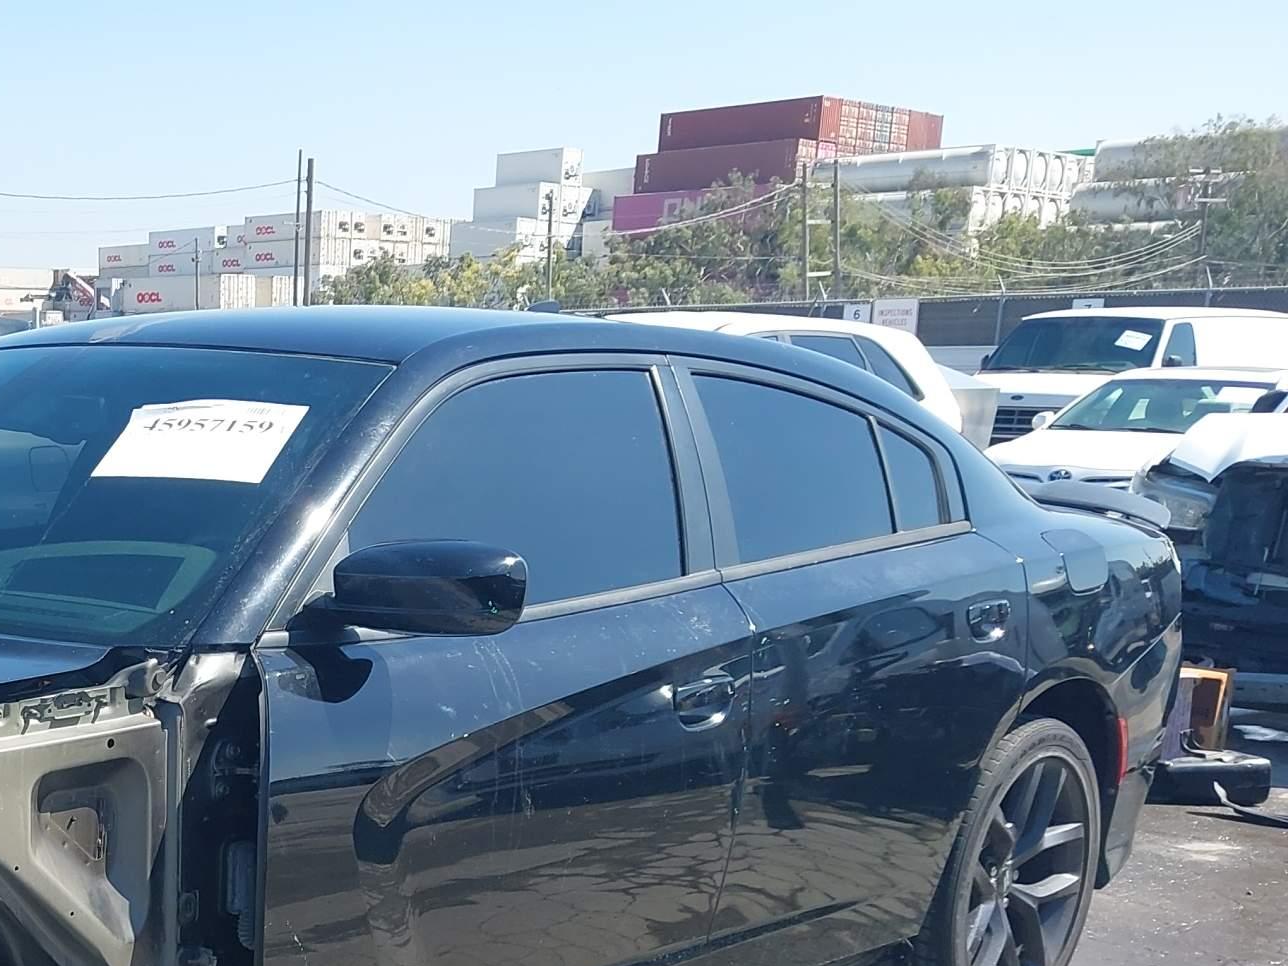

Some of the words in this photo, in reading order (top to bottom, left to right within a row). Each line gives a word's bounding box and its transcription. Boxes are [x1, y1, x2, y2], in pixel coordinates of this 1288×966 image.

[255, 225, 276, 236] OOCL
[158, 240, 177, 249] OOCL
[106, 255, 122, 263] OOCL
[255, 252, 275, 262] OOCL
[158, 263, 176, 273] OOCL
[222, 259, 241, 268] OOCL
[136, 291, 163, 304] OOCL
[853, 309, 861, 320] 6
[143, 417, 275, 434] 45957159
